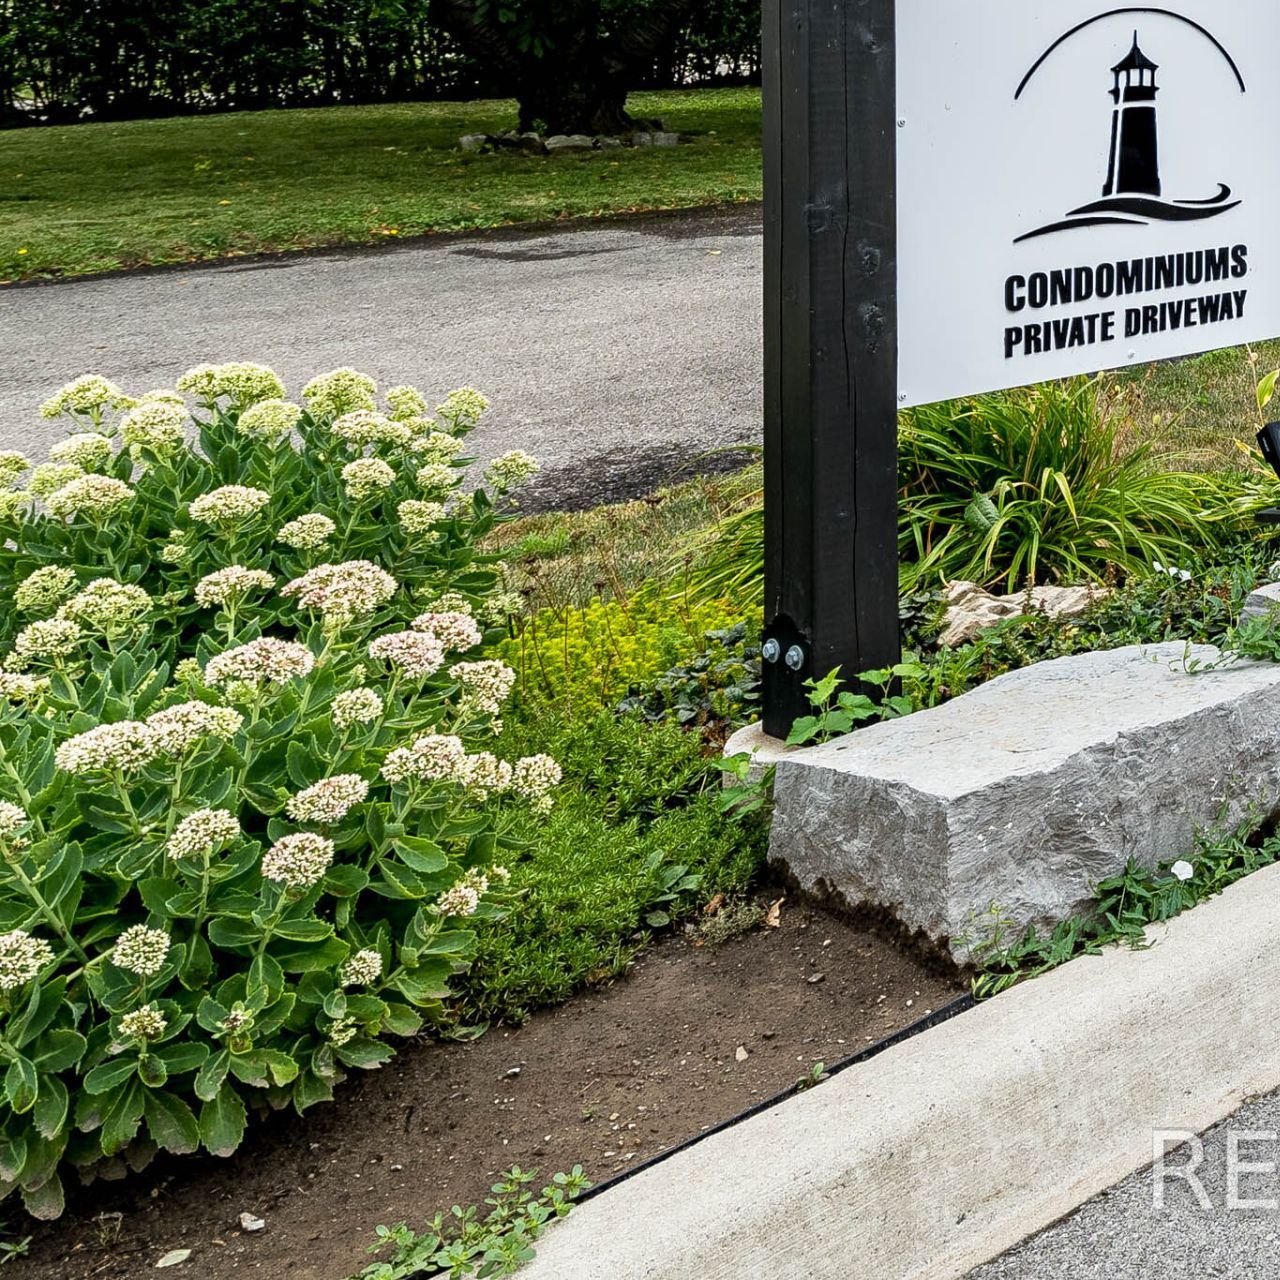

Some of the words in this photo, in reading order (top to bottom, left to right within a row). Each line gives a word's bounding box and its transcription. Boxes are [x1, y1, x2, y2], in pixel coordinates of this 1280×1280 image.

[1004, 244, 1248, 312] CONDOMINIUMS
[1004, 310, 1115, 359] PRIVATE
[1124, 289, 1247, 338] DRIVEWAY
